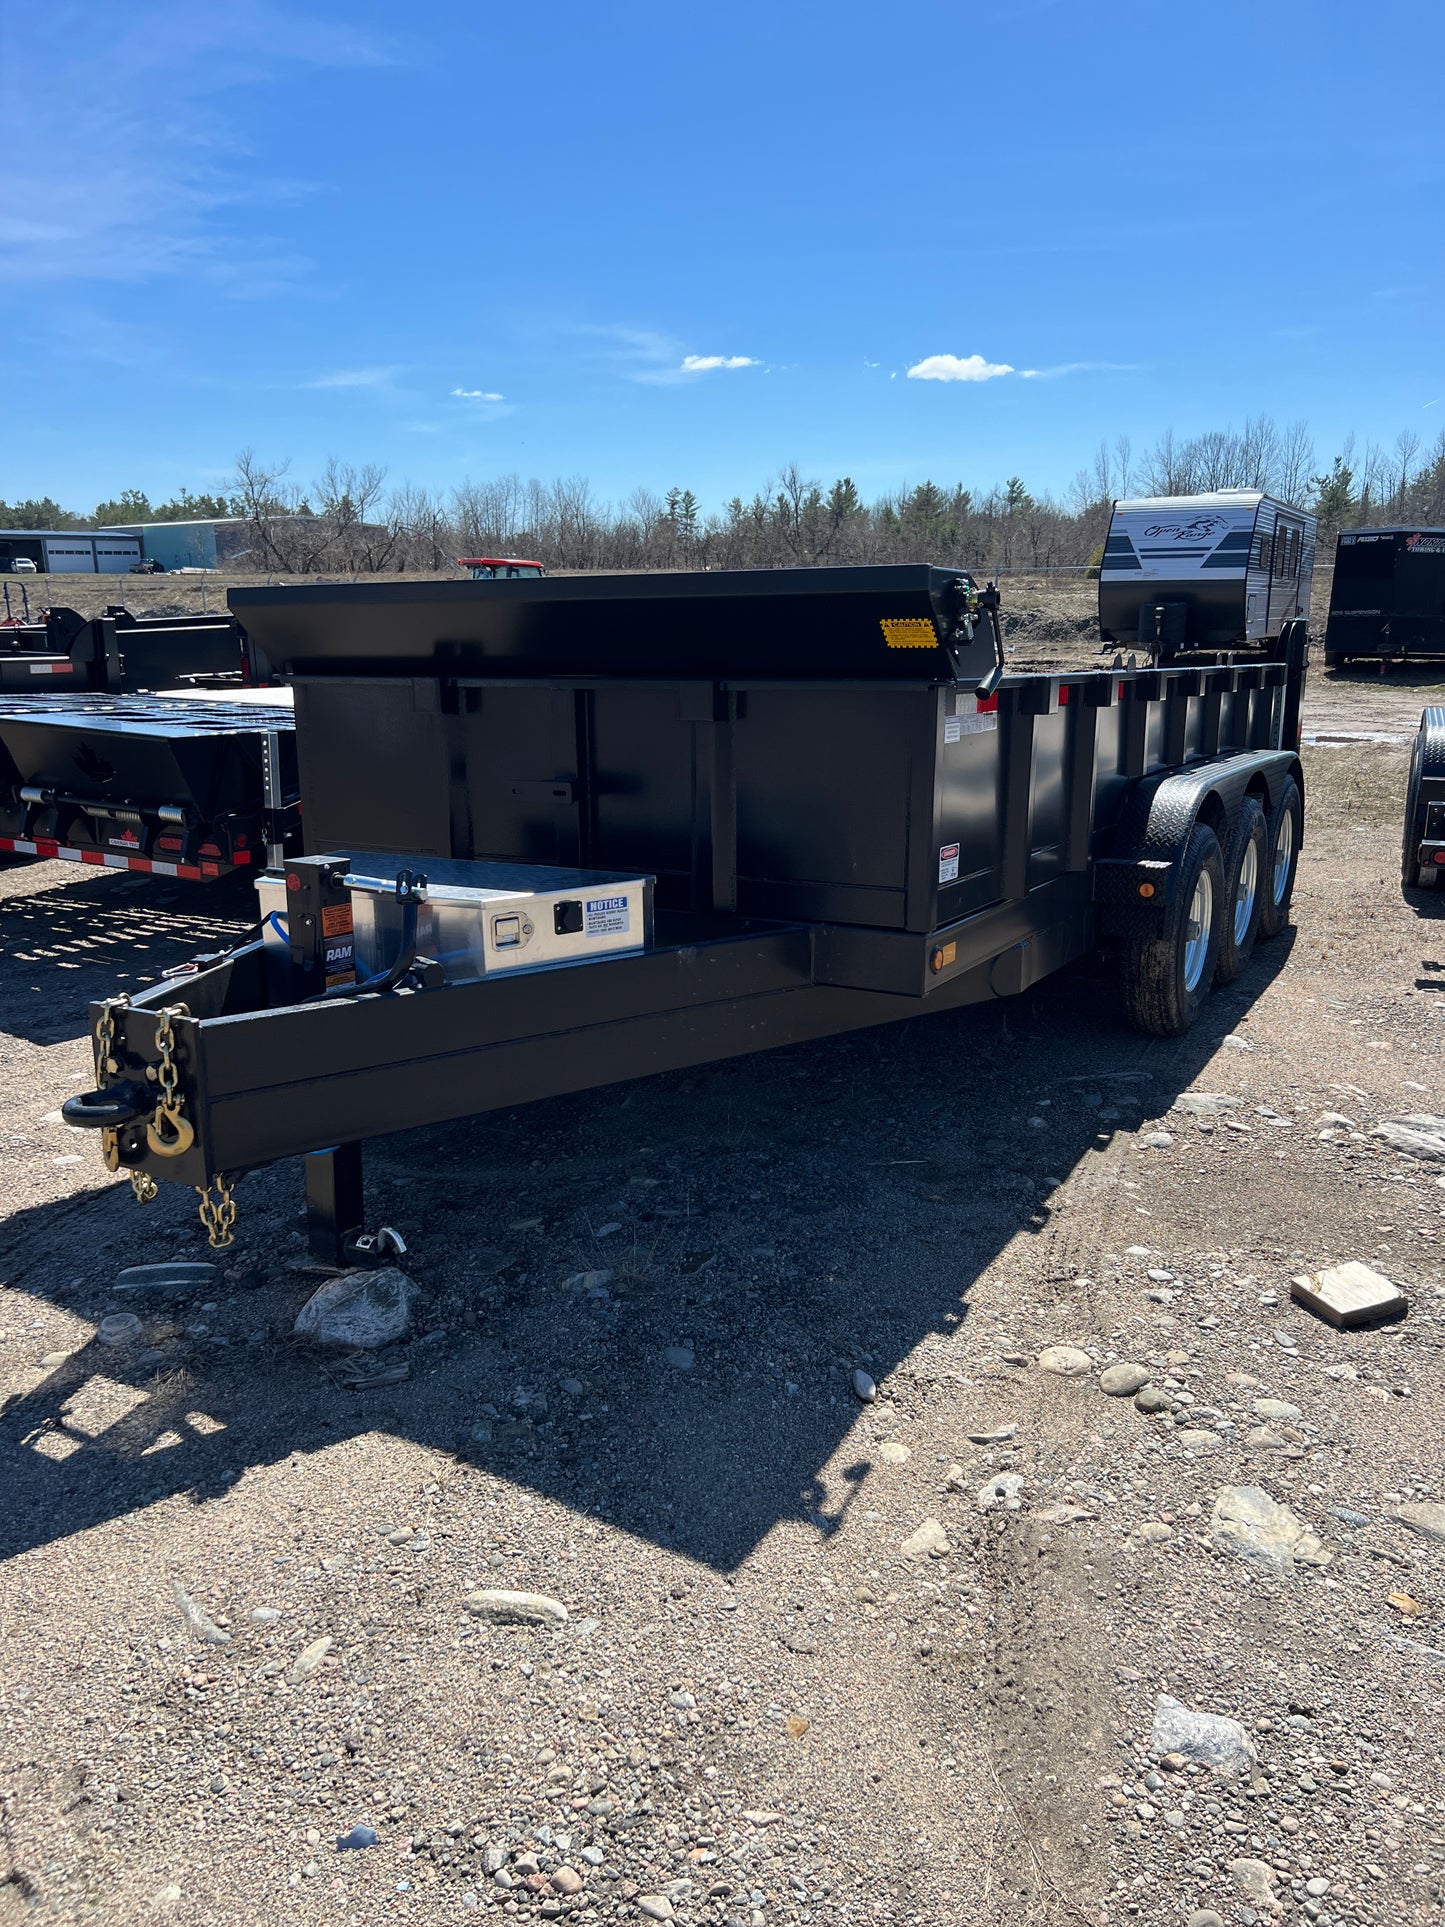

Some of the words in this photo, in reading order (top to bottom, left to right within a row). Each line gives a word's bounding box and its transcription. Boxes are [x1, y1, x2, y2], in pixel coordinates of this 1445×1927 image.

[1144, 525, 1181, 538] Open
[1171, 530, 1215, 541] Range
[590, 898, 624, 911] NOTICE
[326, 946, 352, 962] RAM
